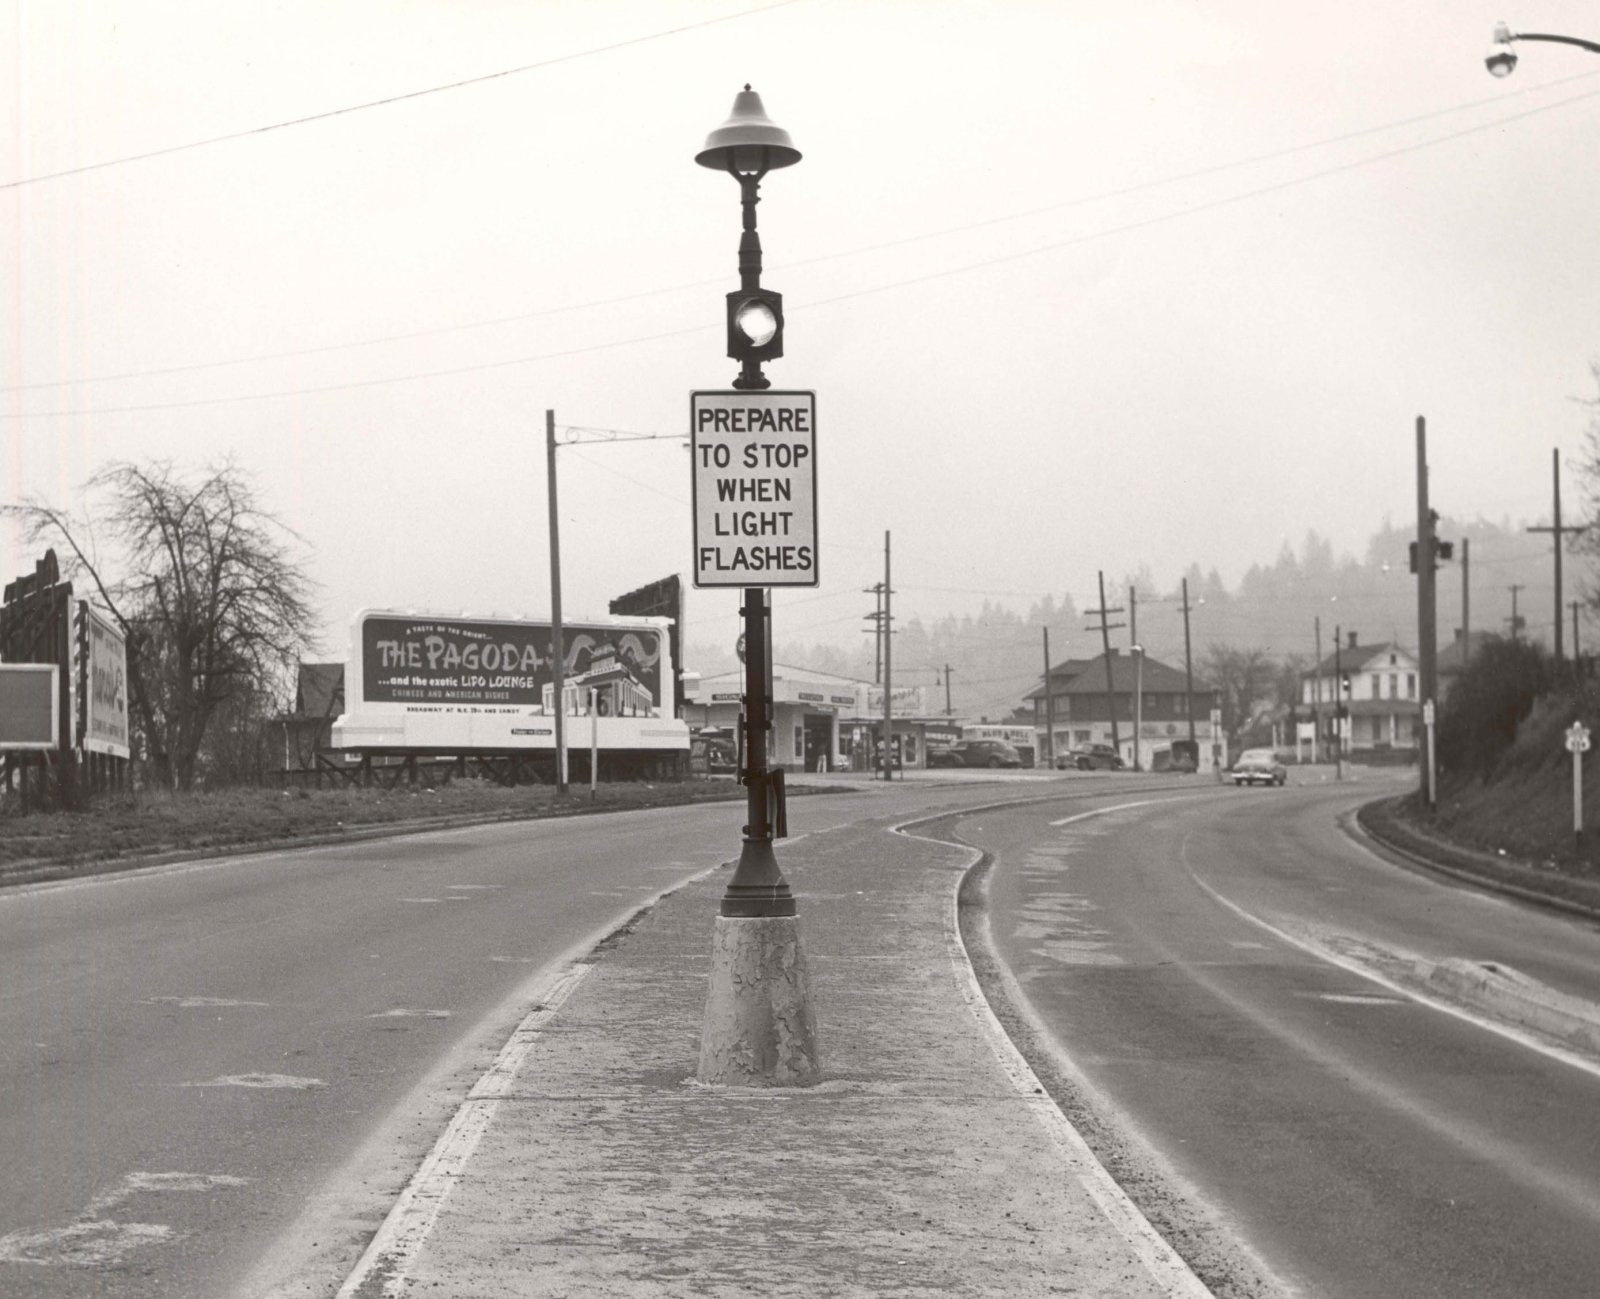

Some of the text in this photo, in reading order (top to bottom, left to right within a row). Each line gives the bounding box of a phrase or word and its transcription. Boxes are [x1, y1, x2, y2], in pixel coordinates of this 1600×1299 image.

[698, 408, 809, 432] PREPARE
[699, 442, 809, 469] TO STOP
[717, 478, 791, 502] WHEN
[715, 511, 793, 537] LIGHT
[700, 546, 812, 571] FLASHES
[376, 635, 544, 672] THE PAGODA
[392, 688, 509, 700] CHINESE AND AMERICAN DISHES
[412, 676, 428, 686] the
[429, 677, 459, 687] exotic
[488, 676, 534, 689] LOUNGE
